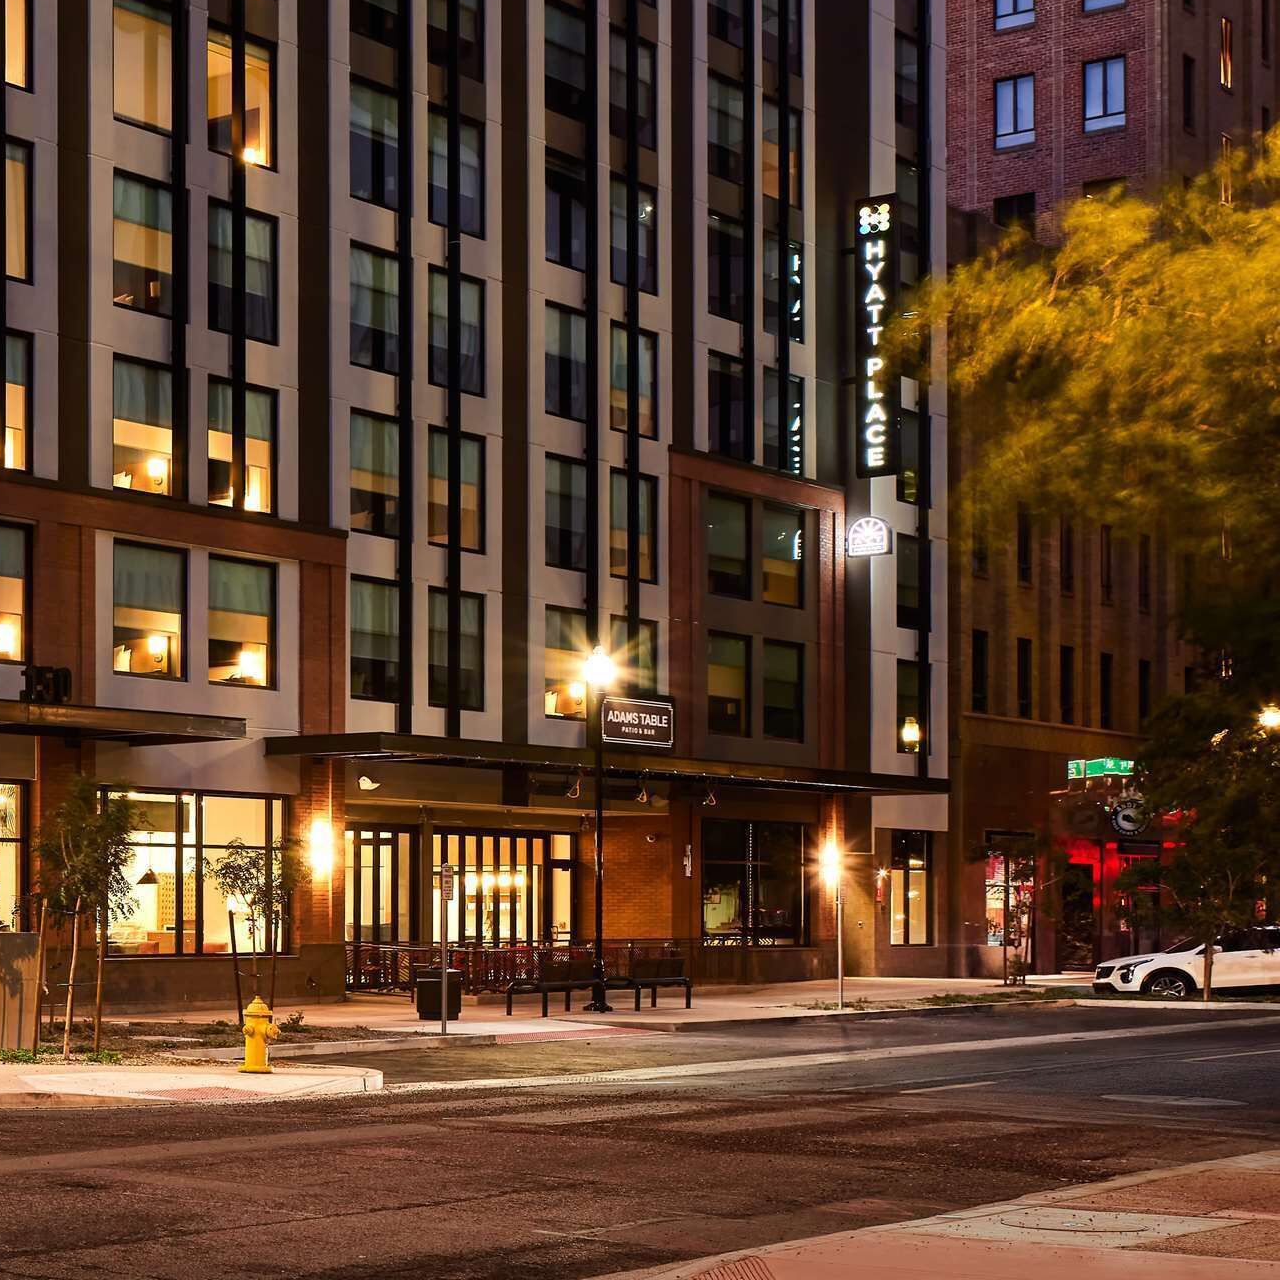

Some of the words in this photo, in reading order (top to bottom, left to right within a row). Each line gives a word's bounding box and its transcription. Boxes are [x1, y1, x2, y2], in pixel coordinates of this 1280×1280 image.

[864, 240, 885, 347] HYATT
[865, 357, 887, 467] PLACE
[607, 710, 639, 724] ADAMS
[640, 714, 669, 727] TABLE
[621, 726, 639, 735] PATIO
